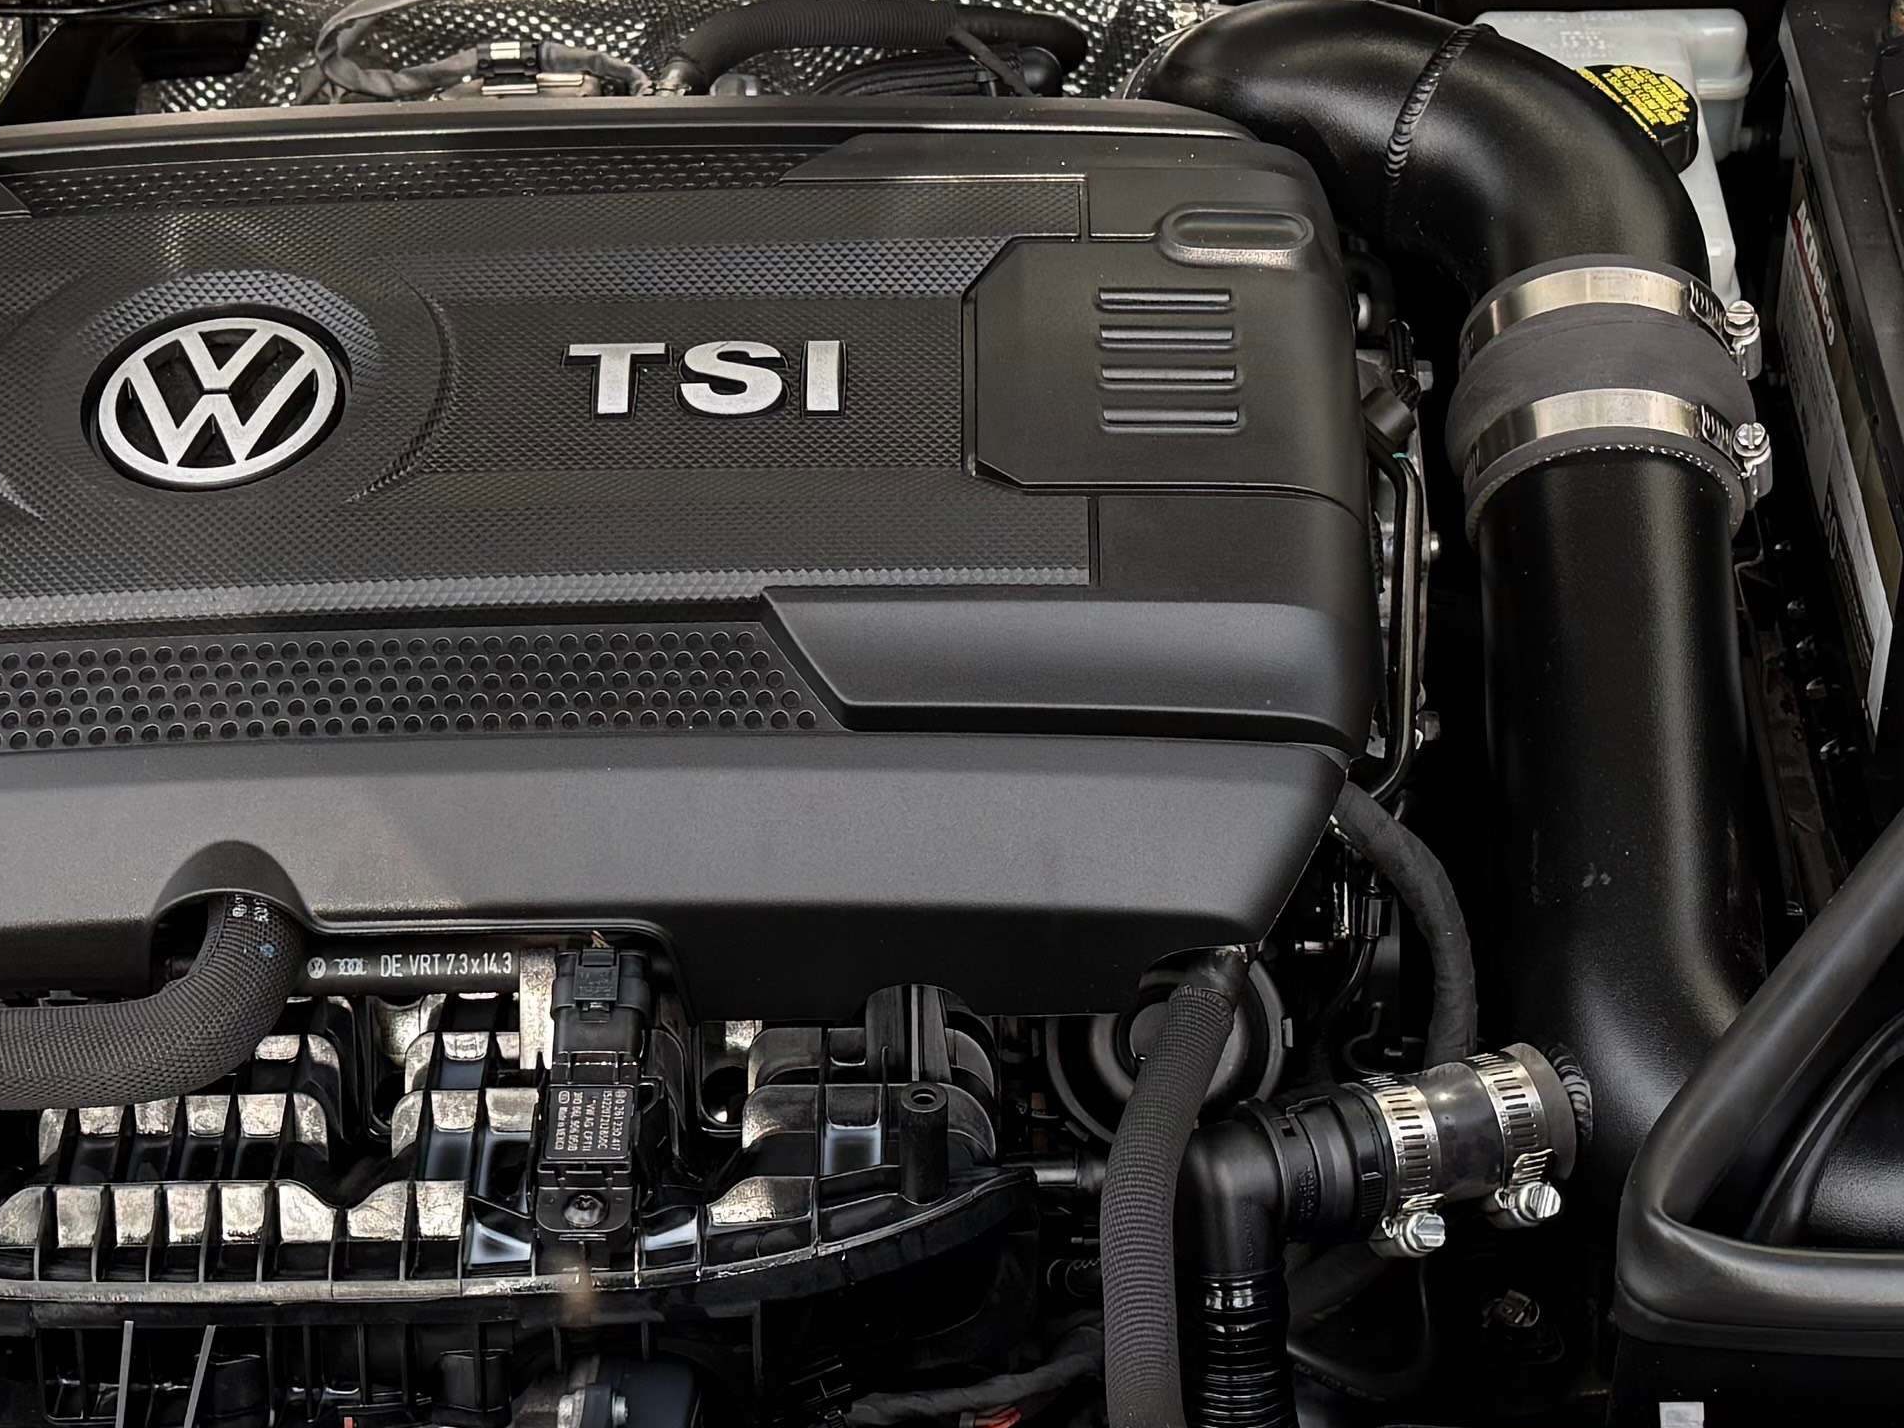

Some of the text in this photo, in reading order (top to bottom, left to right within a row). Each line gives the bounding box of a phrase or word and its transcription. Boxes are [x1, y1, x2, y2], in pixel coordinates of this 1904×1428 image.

[96, 316, 848, 486] VW TSI
[380, 955, 403, 977] DE
[410, 954, 441, 976] VRT
